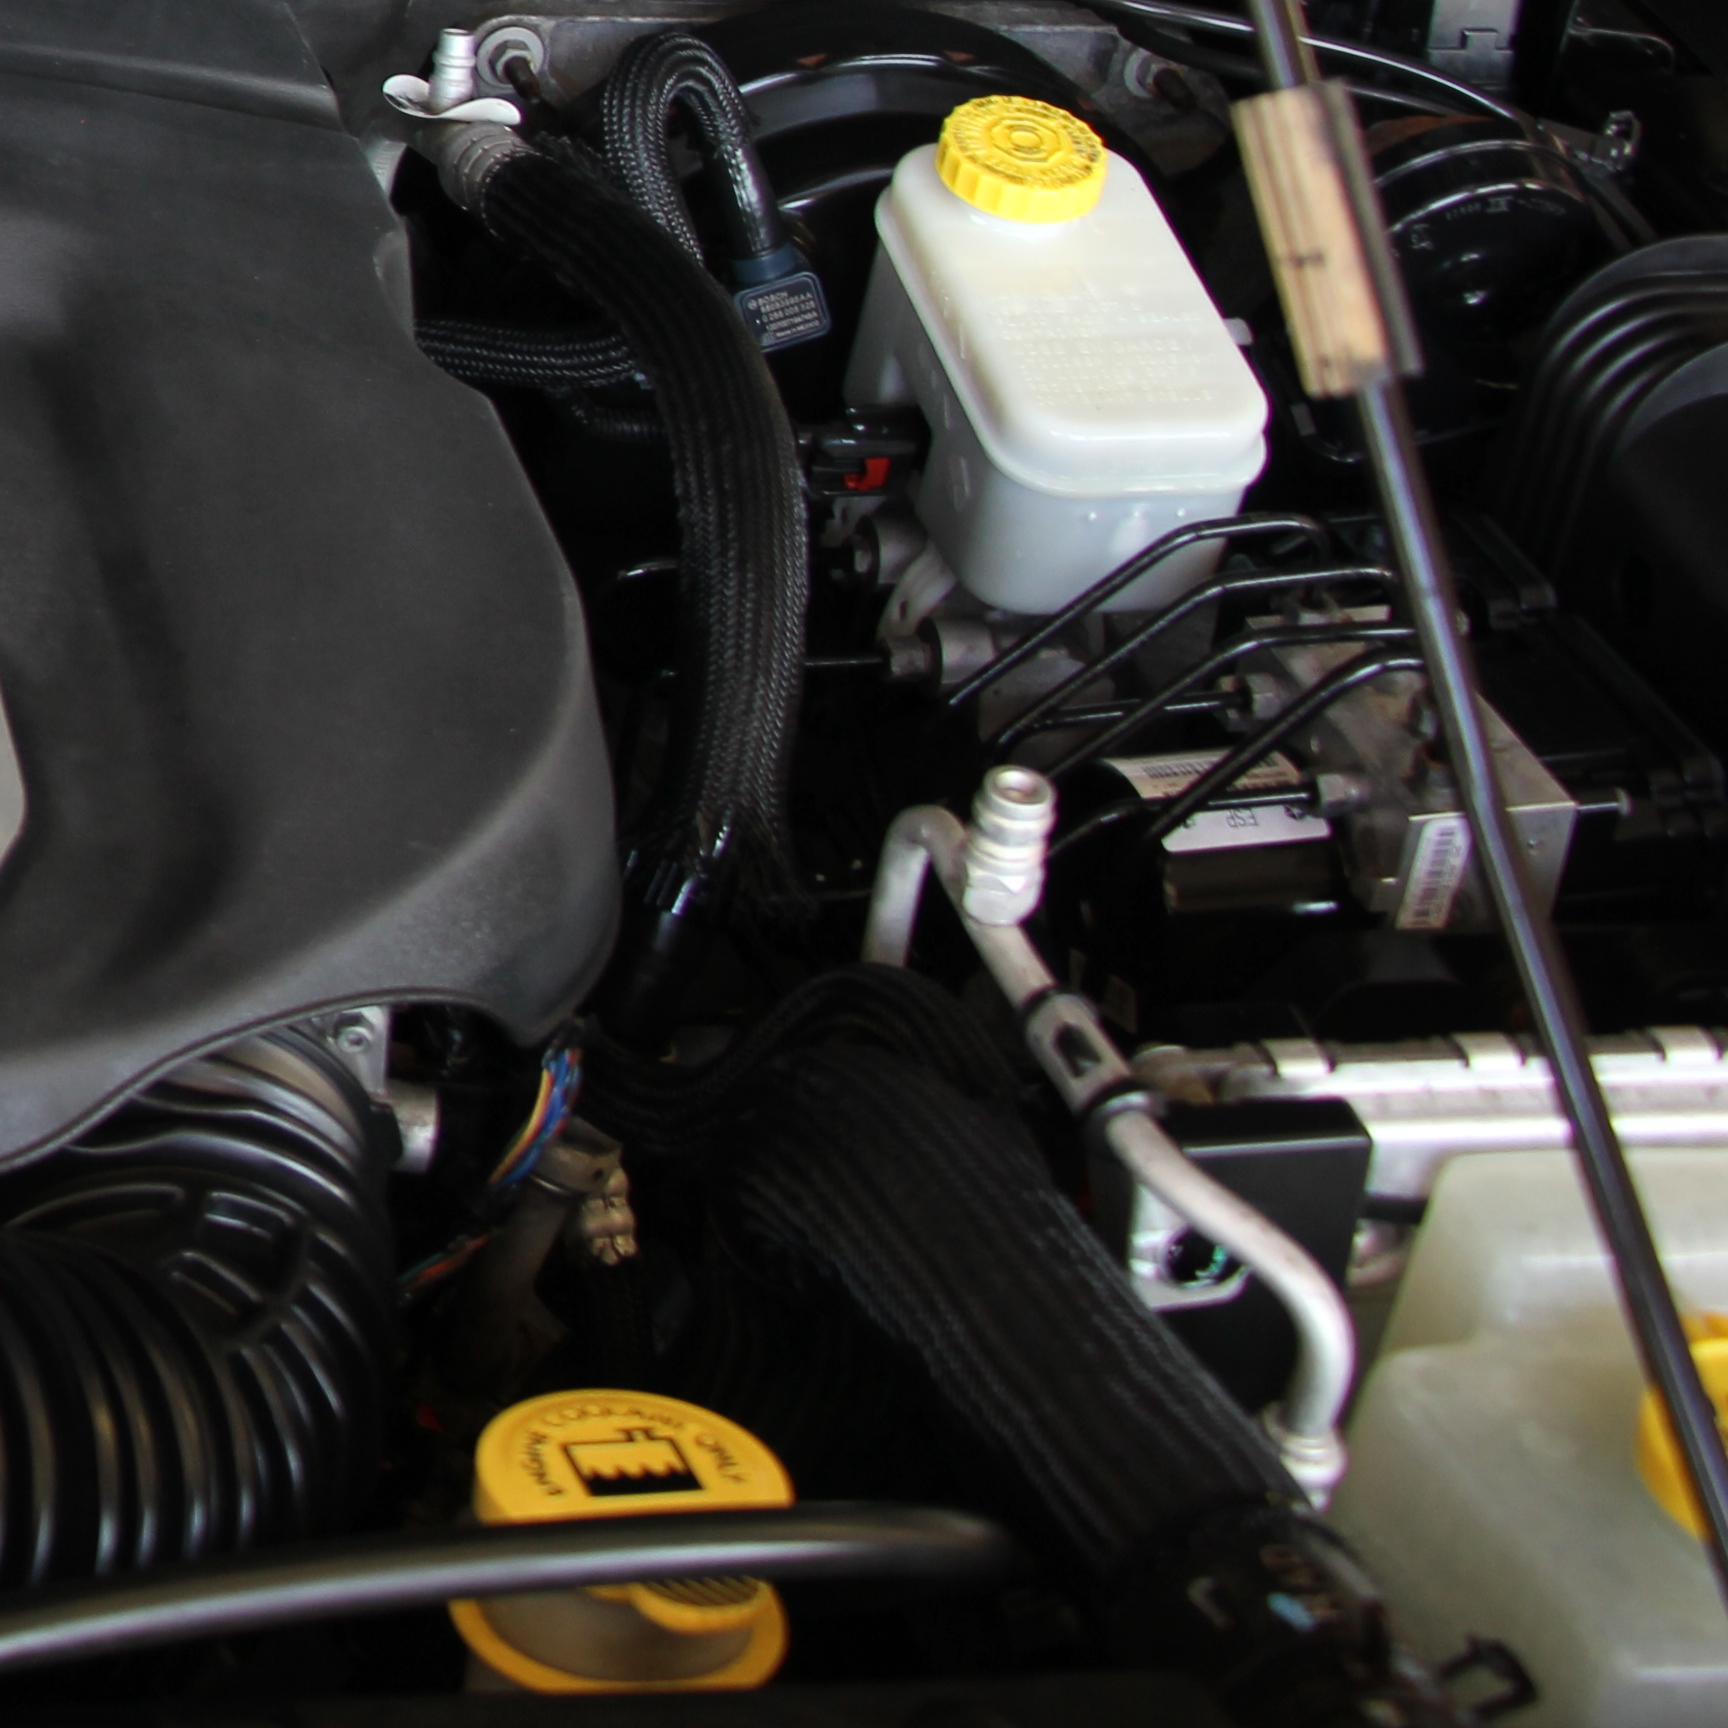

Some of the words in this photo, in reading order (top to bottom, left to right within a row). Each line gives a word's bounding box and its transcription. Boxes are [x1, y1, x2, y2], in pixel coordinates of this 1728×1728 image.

[757, 291, 788, 306] BOSCH
[544, 1404, 685, 1430] COOLANT
[694, 1432, 746, 1484] ONLY
